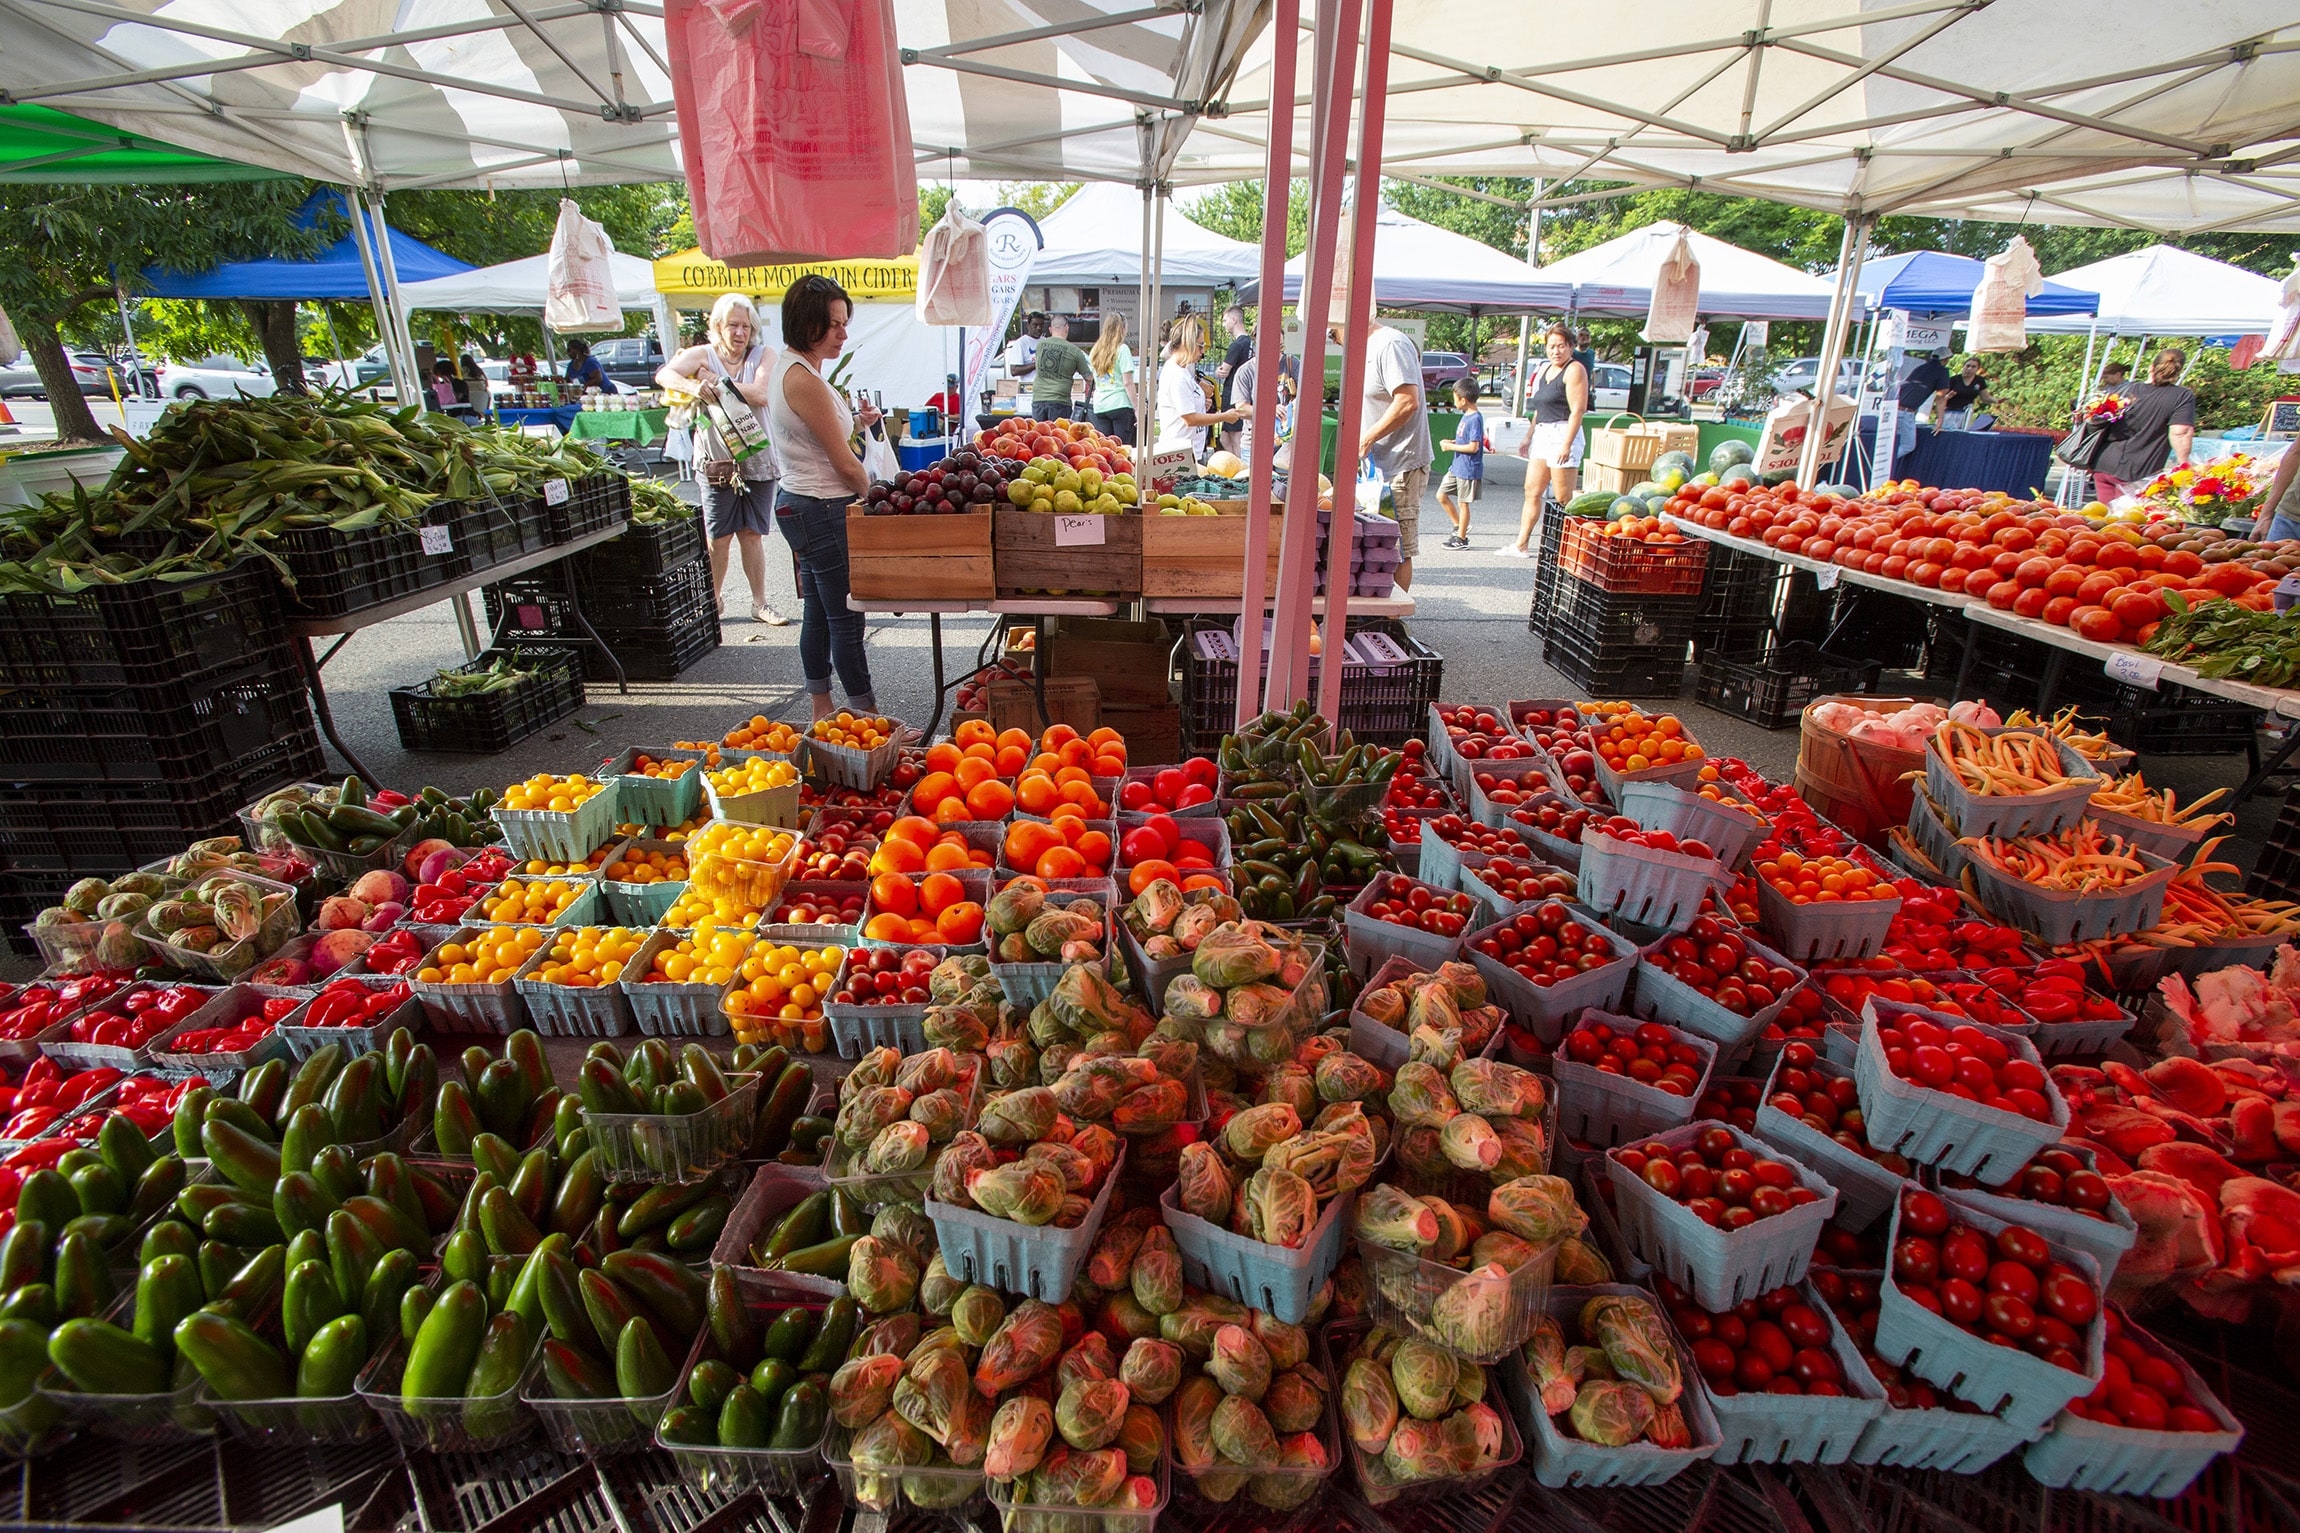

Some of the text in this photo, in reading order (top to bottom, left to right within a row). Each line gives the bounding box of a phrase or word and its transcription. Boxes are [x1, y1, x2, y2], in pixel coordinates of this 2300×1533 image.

[683, 266, 760, 291] COBBLER
[863, 266, 916, 291] CIDER
[993, 274, 1017, 283] ARS
